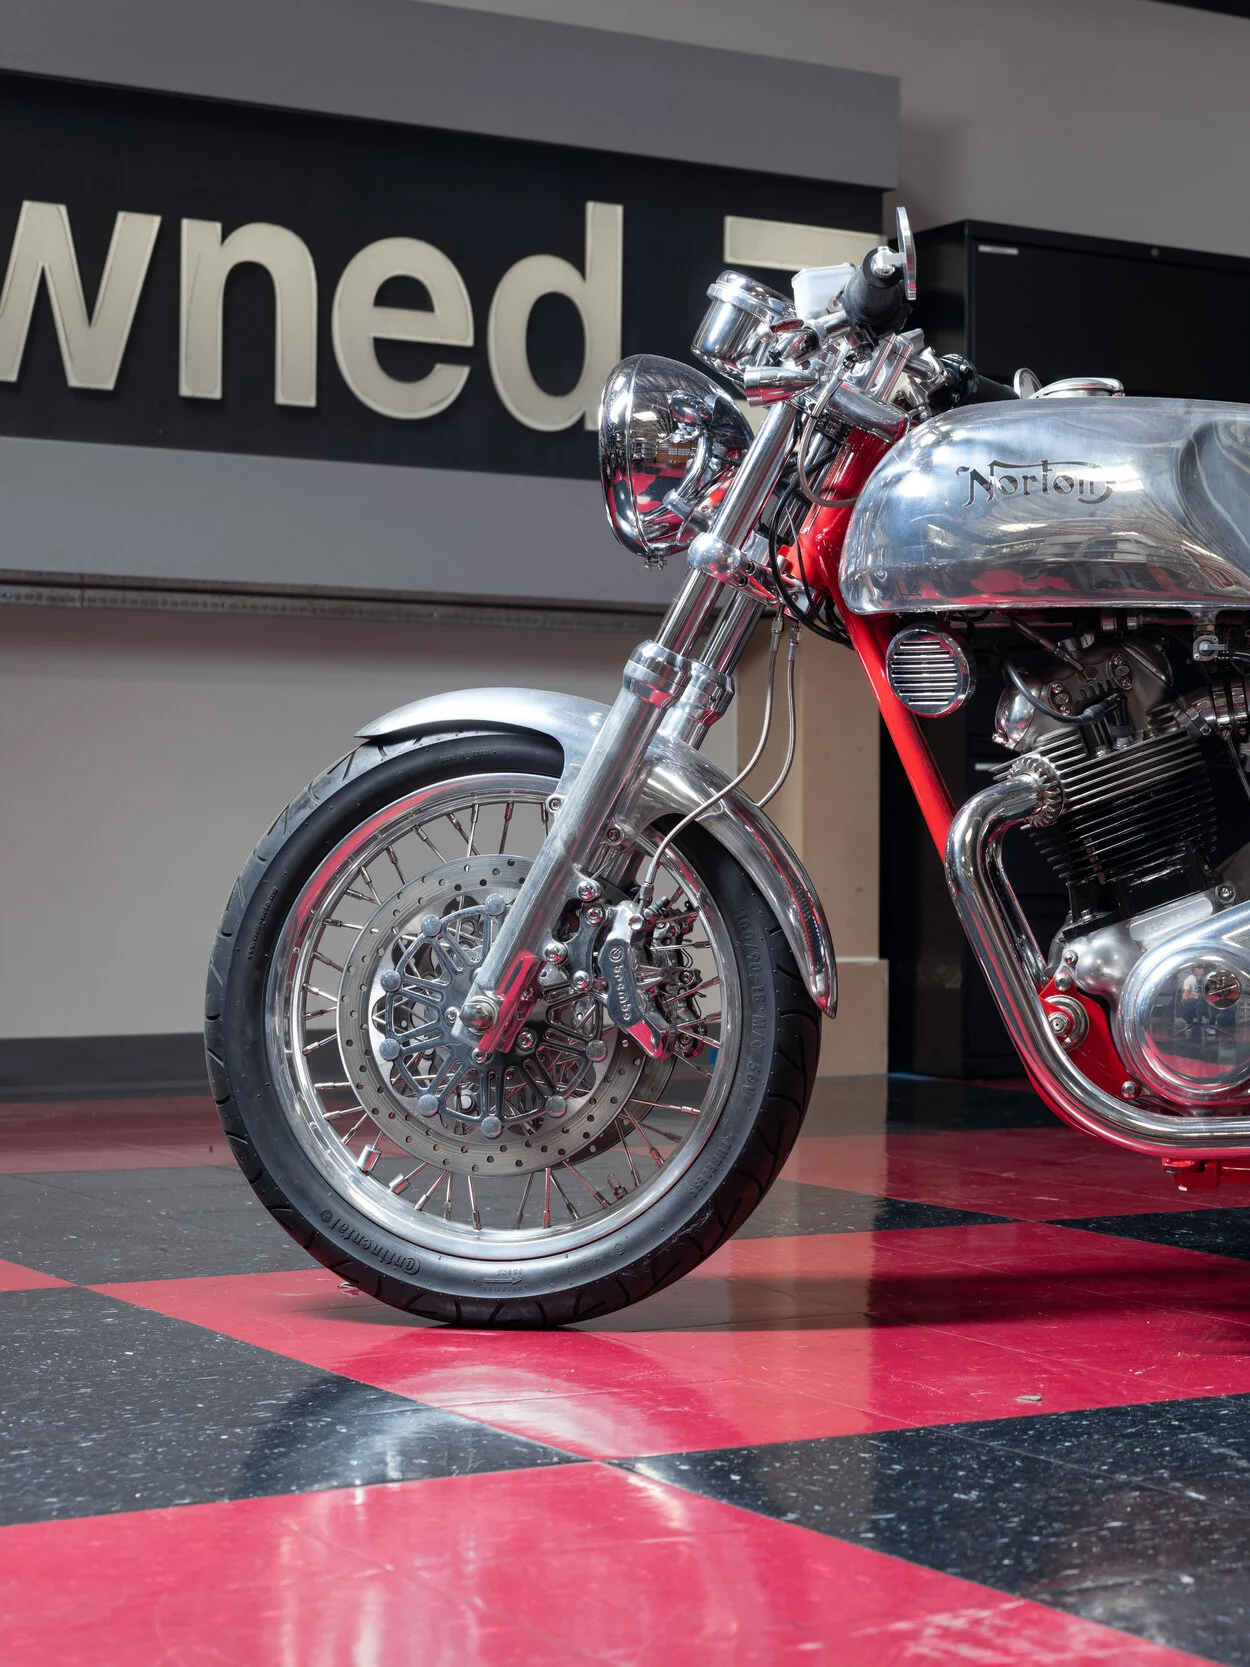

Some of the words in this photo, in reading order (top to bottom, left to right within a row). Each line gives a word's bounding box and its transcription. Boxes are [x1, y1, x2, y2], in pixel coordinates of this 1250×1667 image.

[0, 200, 624, 432] wned
[955, 459, 1116, 508] Norton
[613, 962, 632, 1021] brembo
[328, 1215, 422, 1277] Continental
